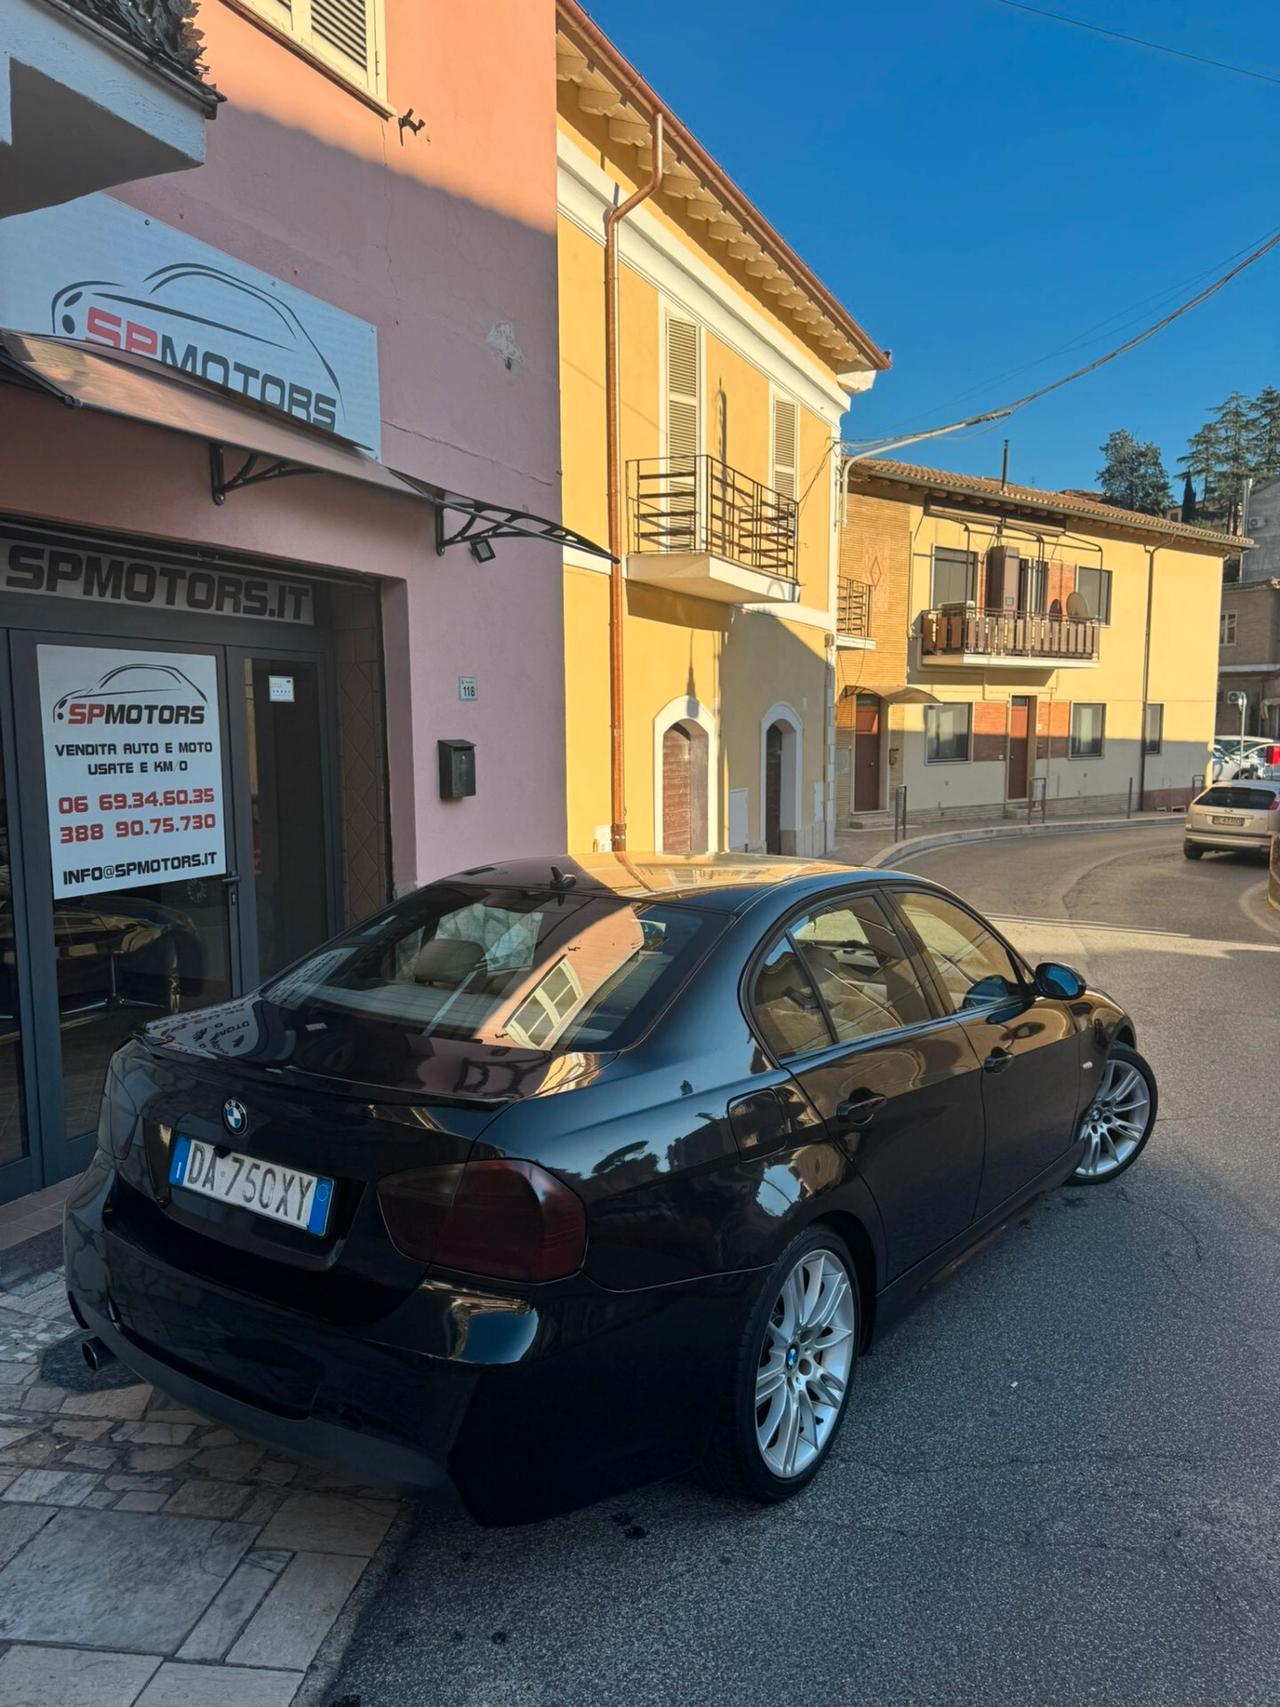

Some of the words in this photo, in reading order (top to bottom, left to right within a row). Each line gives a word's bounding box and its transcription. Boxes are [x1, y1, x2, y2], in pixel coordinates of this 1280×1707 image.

[86, 306, 338, 432] SPMOTORS
[6, 545, 310, 620] SPMOTORS.IT
[67, 703, 205, 725] SPMOTORS
[55, 743, 117, 757] VENDITA
[123, 742, 159, 755] AUTO
[165, 742, 173, 754] E
[178, 741, 213, 754] MOTO
[87, 762, 134, 775] USATE
[140, 761, 148, 773] E
[58, 795, 89, 814] 06
[99, 787, 215, 811] 69.34.60.35
[60, 823, 104, 844] 388
[115, 813, 217, 838] 90.75.730
[63, 852, 218, 885] INFO@SPMOTORS.IT
[187, 1143, 217, 1191] DA
